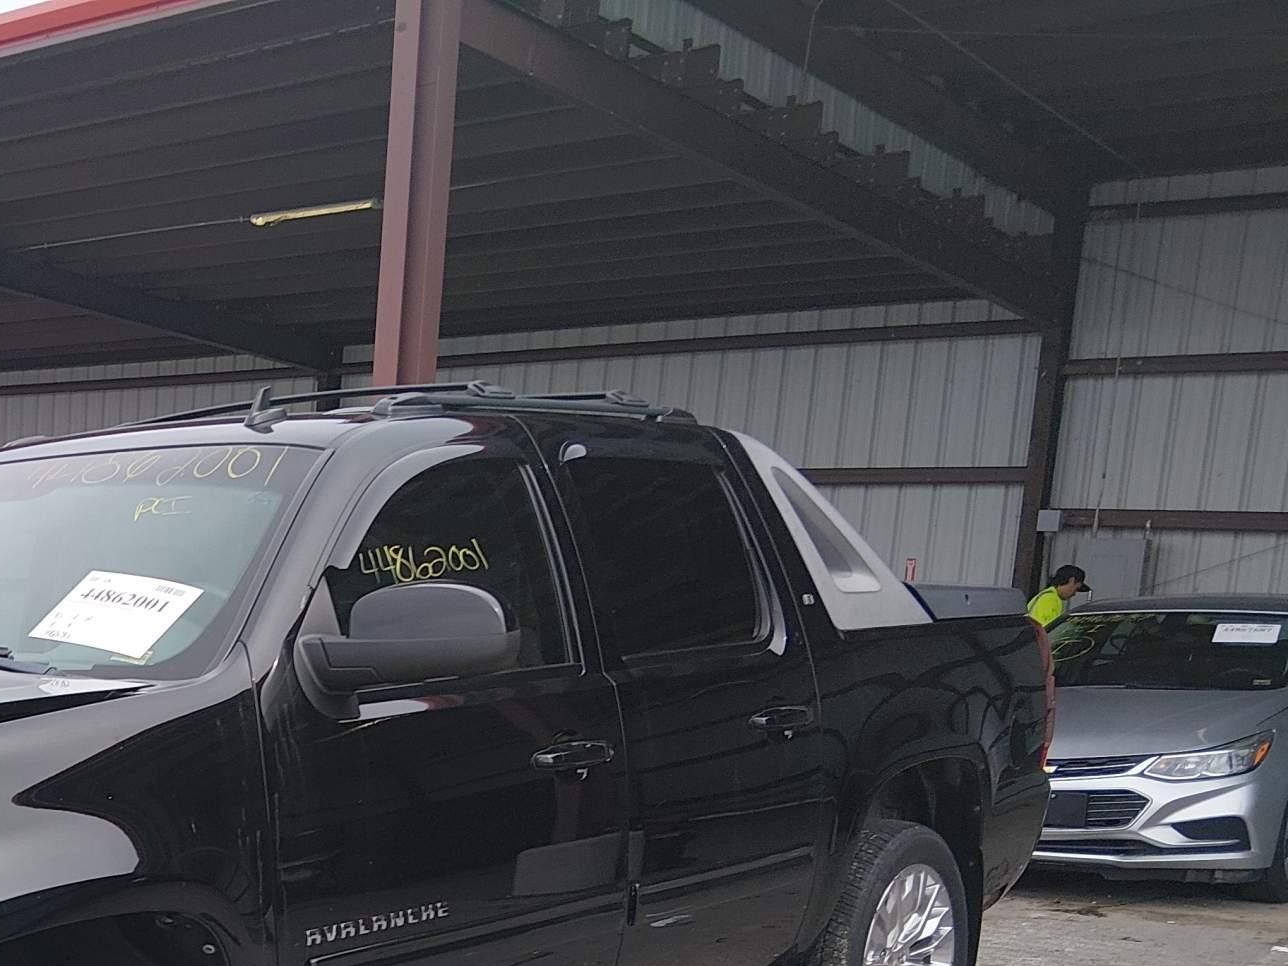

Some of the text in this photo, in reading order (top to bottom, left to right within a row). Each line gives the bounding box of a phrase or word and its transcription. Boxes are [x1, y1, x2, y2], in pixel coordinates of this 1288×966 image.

[358, 538, 489, 584] 44862001
[80, 587, 171, 613] 44862001
[305, 901, 449, 946] AVALANCHE
